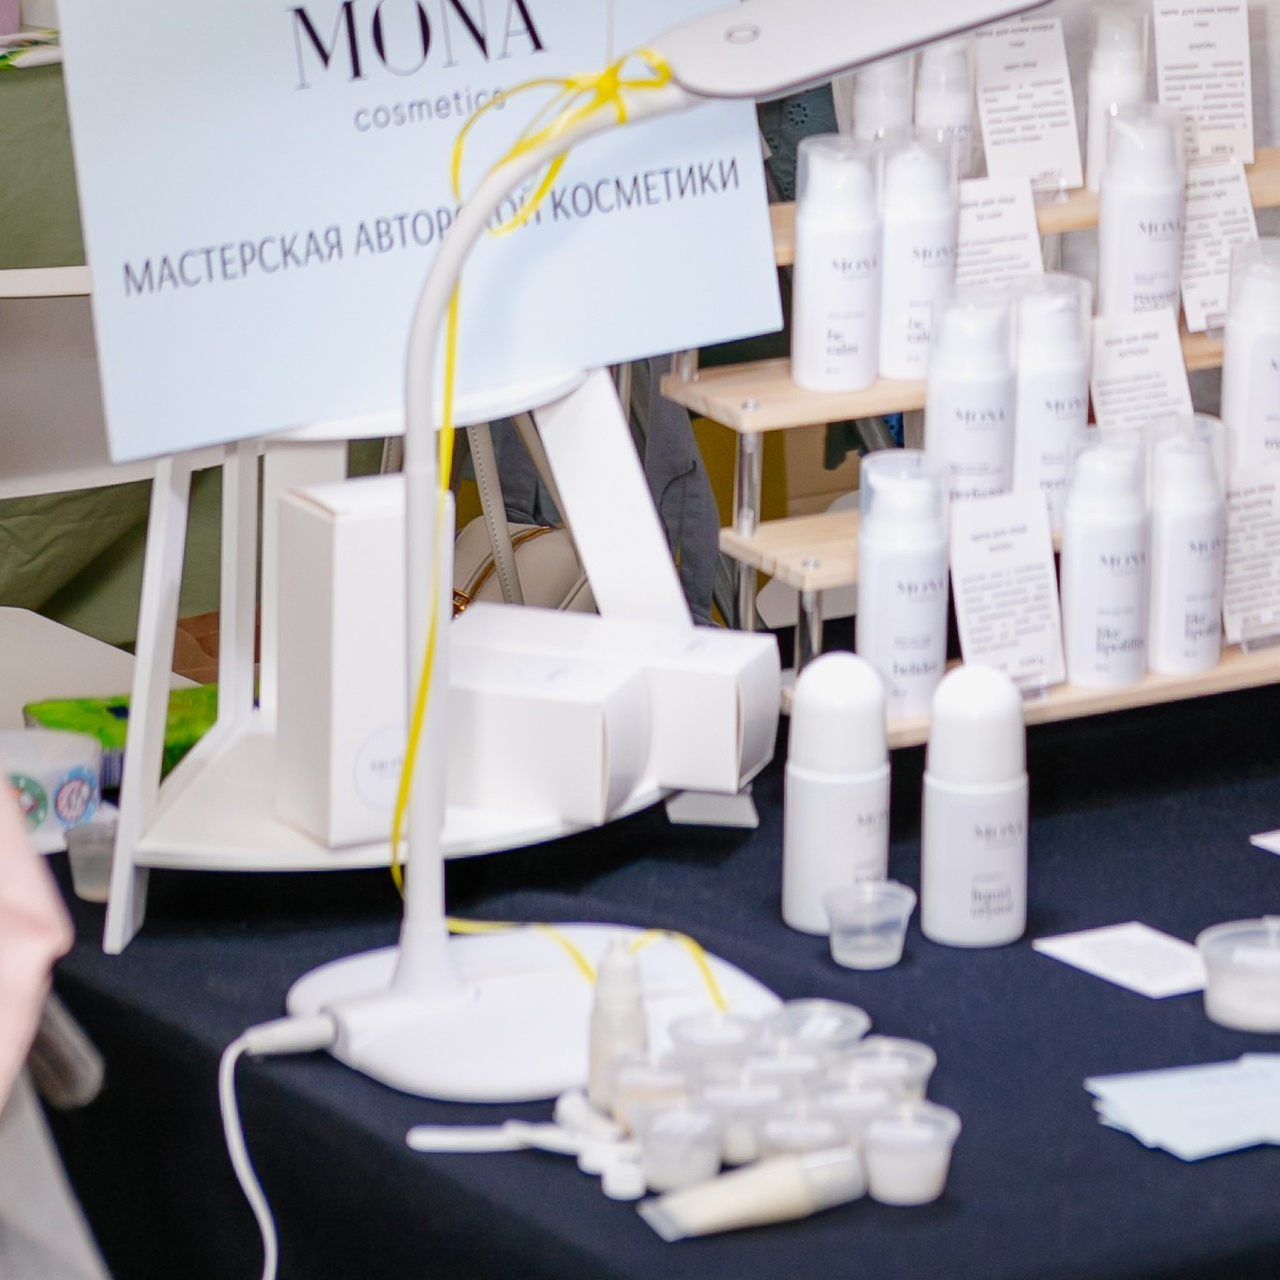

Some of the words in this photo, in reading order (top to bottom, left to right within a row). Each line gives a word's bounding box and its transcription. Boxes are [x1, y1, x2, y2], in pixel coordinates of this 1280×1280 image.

[353, 86, 507, 133] cosmetics
[123, 225, 343, 298] МАСТЕРСКАЯ
[353, 181, 541, 257] АВТОРОЙ
[551, 156, 740, 223] КОСМЕТИКИ
